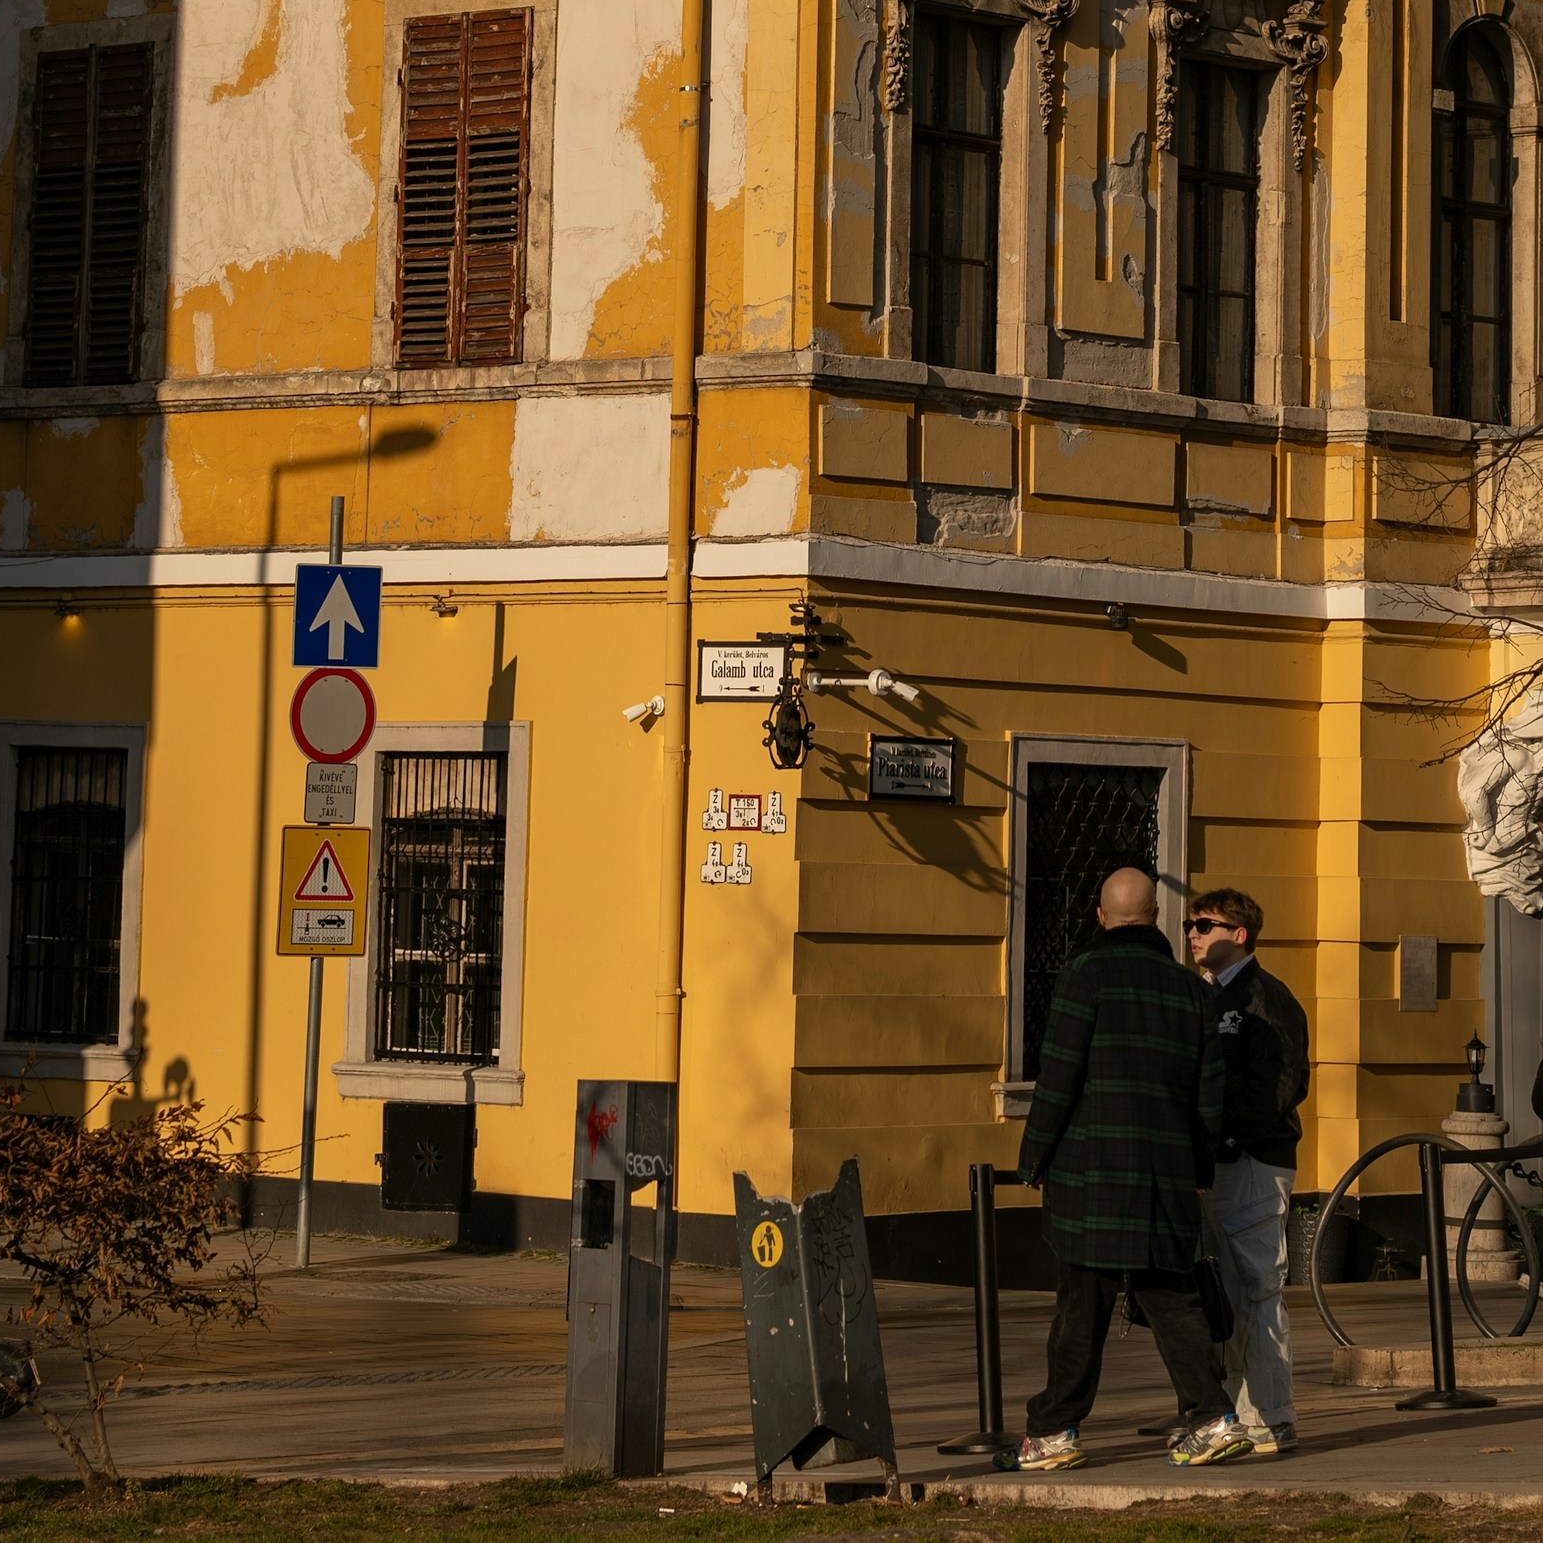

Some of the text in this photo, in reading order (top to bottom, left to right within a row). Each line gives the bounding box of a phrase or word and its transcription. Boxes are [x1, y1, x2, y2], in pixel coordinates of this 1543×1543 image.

[746, 650, 768, 658] Belváros
[711, 660, 774, 678] Galamb utca
[878, 757, 947, 779] Piarista utca
[320, 771, 343, 782] KIVÉVE
[308, 783, 353, 794] ENGEDÉLLYEL
[326, 794, 334, 805] ÉS
[322, 808, 337, 816] TAXI
